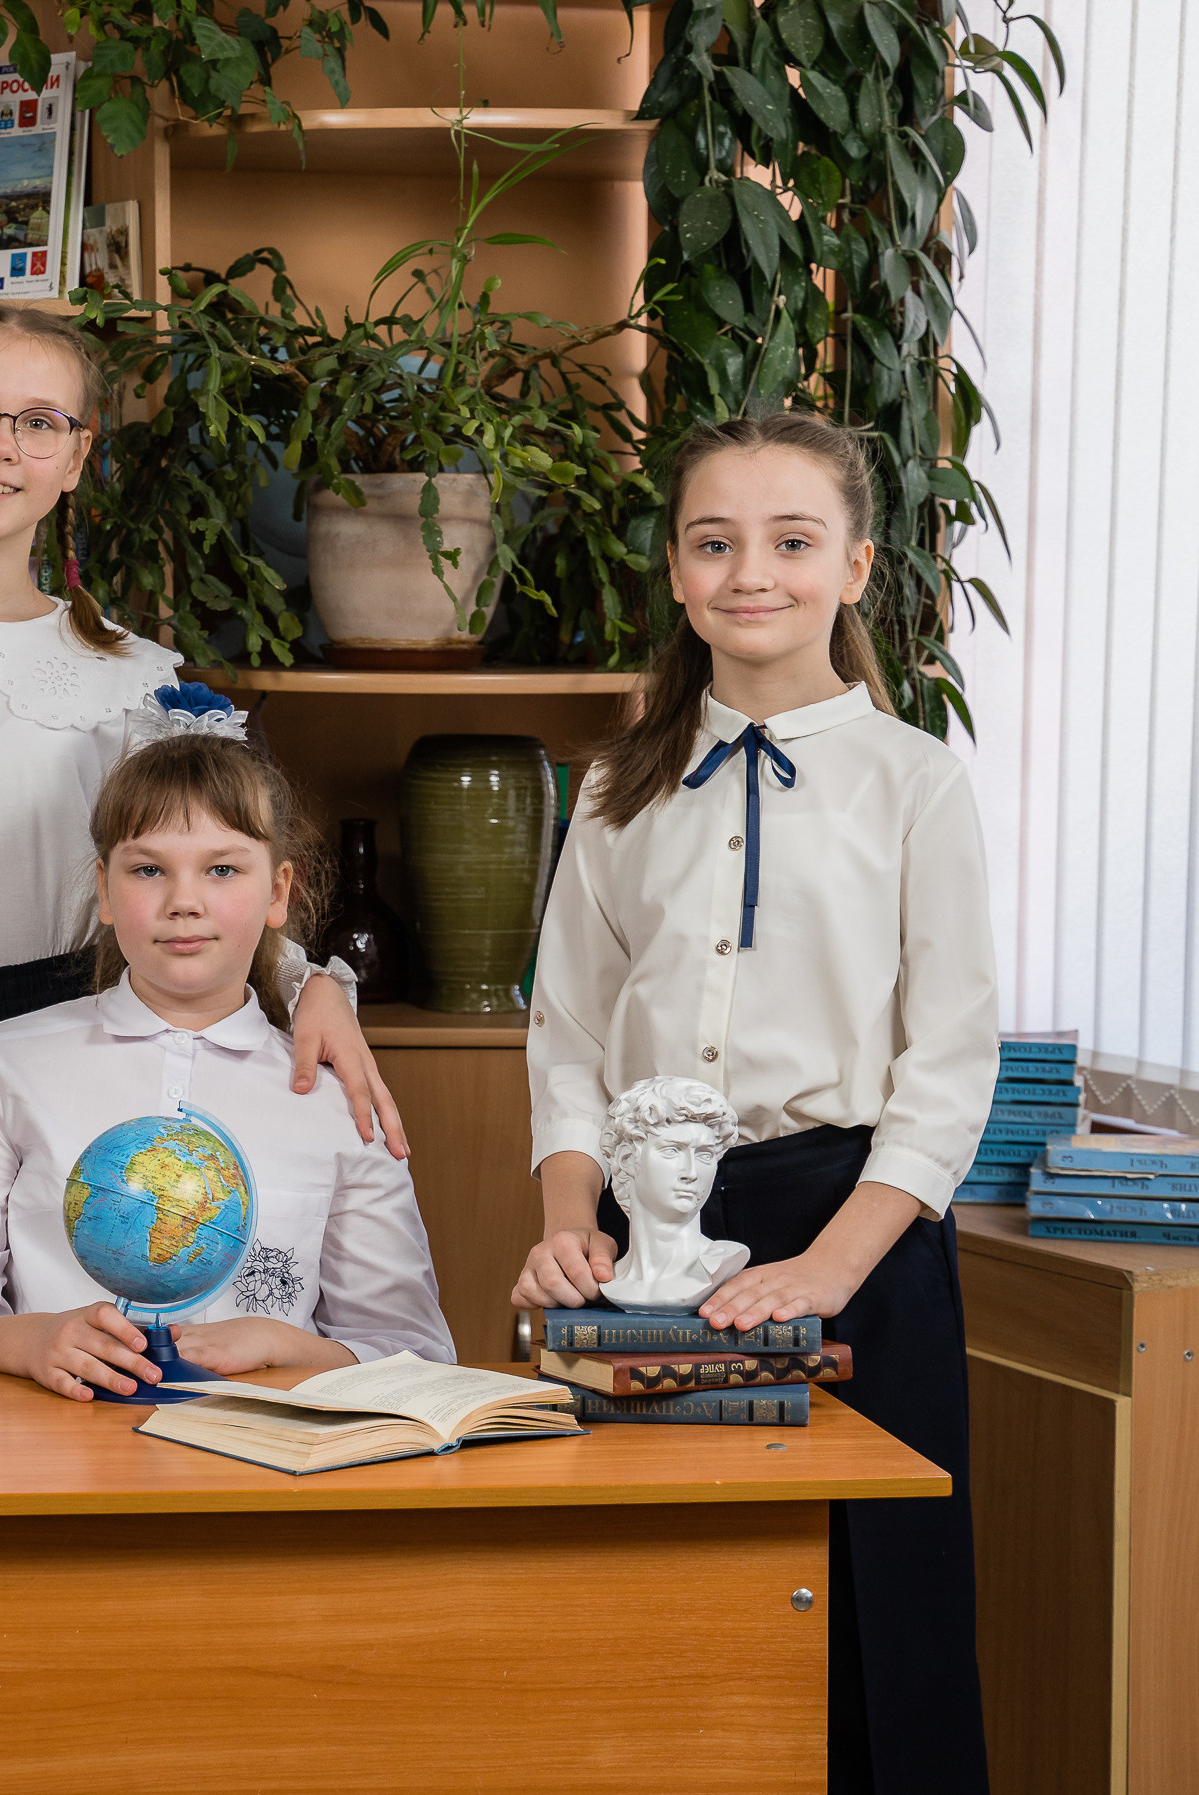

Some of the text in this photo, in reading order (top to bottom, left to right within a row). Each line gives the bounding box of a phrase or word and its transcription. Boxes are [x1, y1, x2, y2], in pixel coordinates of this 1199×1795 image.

[0, 74, 61, 95] РОСИ
[1061, 1155, 1074, 1163] 3
[604, 1325, 692, 1344] ПУШКИН
[699, 1363, 725, 1374] КУПЕР
[731, 1363, 743, 1371] 3
[585, 1400, 674, 1416] ПУШКИН
